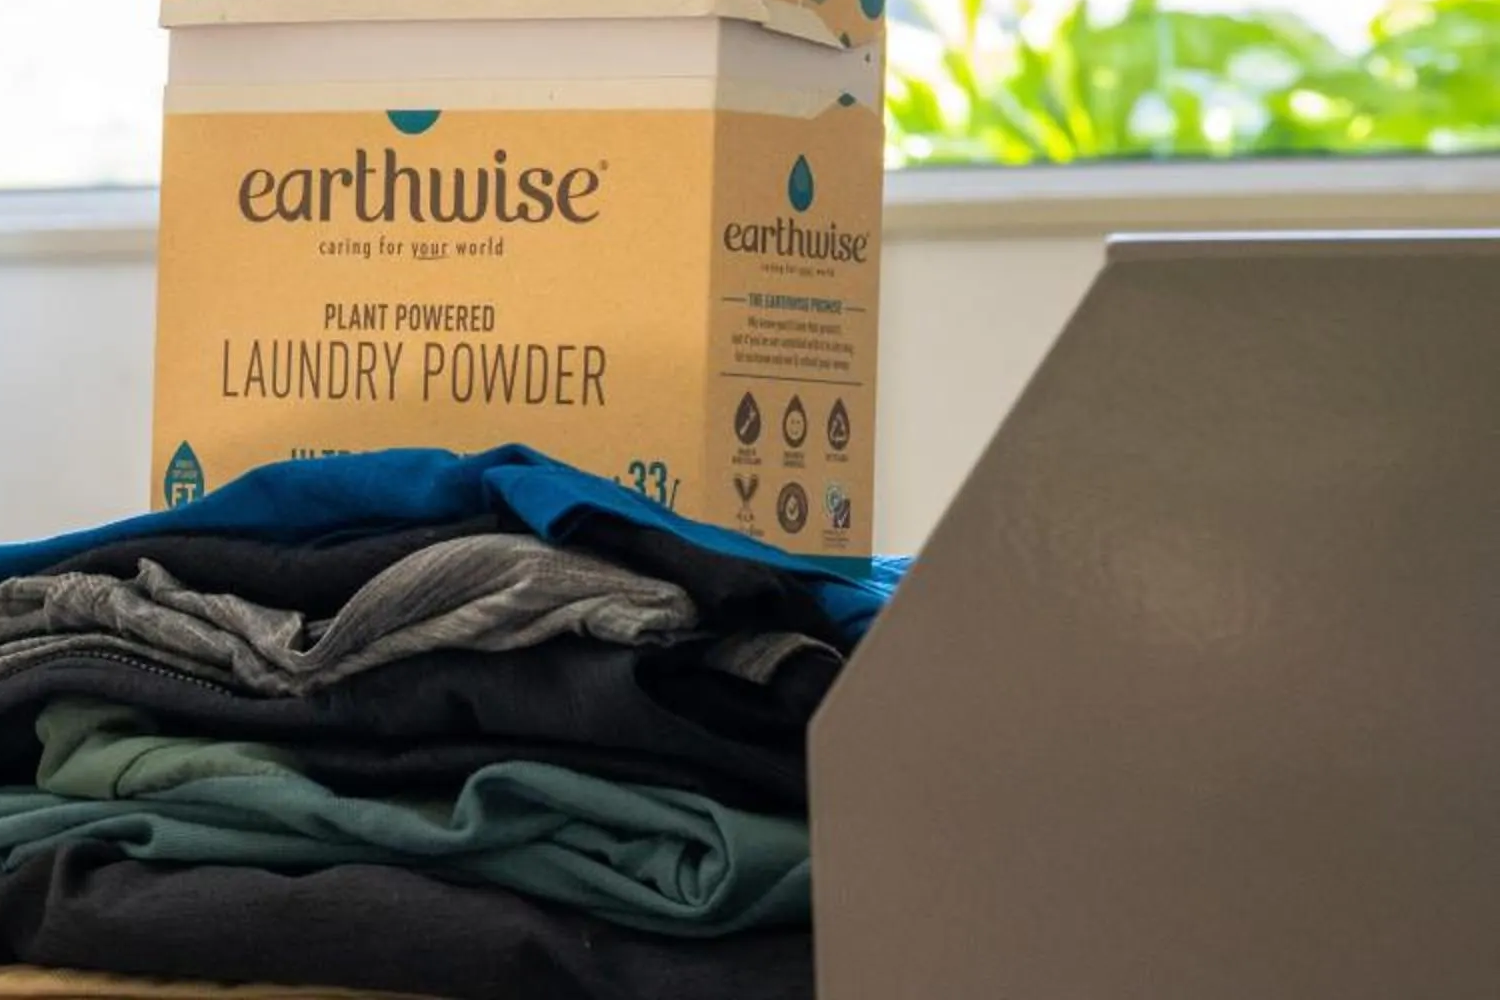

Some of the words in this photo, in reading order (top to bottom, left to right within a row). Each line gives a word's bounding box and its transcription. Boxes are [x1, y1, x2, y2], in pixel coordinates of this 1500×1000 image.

[238, 147, 601, 224] earthwise
[318, 238, 373, 259] caring
[379, 236, 404, 256] for
[411, 240, 448, 260] your
[456, 237, 504, 257] world
[723, 216, 870, 264] earthwise
[324, 303, 389, 331] PLANT
[395, 304, 495, 332] POWERED
[222, 339, 404, 401] LAUNDRY
[422, 342, 607, 406] POWDER
